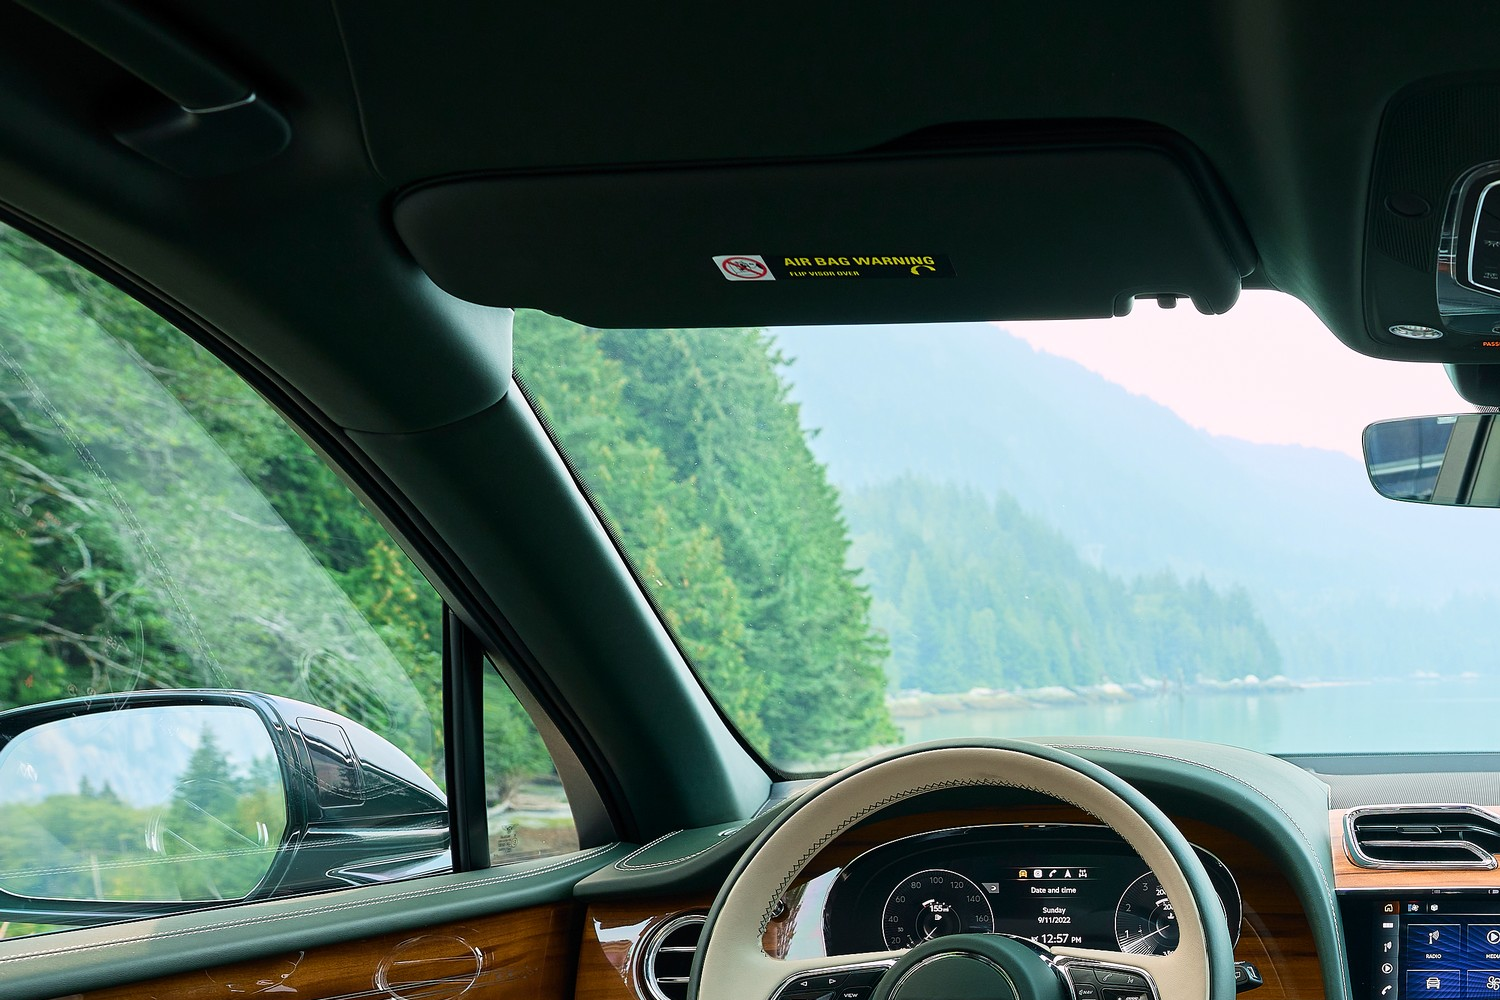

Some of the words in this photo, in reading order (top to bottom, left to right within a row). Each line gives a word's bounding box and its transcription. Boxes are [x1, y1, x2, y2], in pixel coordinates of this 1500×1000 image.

[785, 257, 812, 267] AIR
[817, 257, 850, 266] BAG
[852, 256, 935, 265] WARNING
[1143, 883, 1149, 891] 3
[1042, 907, 1066, 915] Sunday
[1126, 904, 1131, 912] 2
[1125, 930, 1129, 938] 1
[1042, 934, 1069, 944] 12:57
